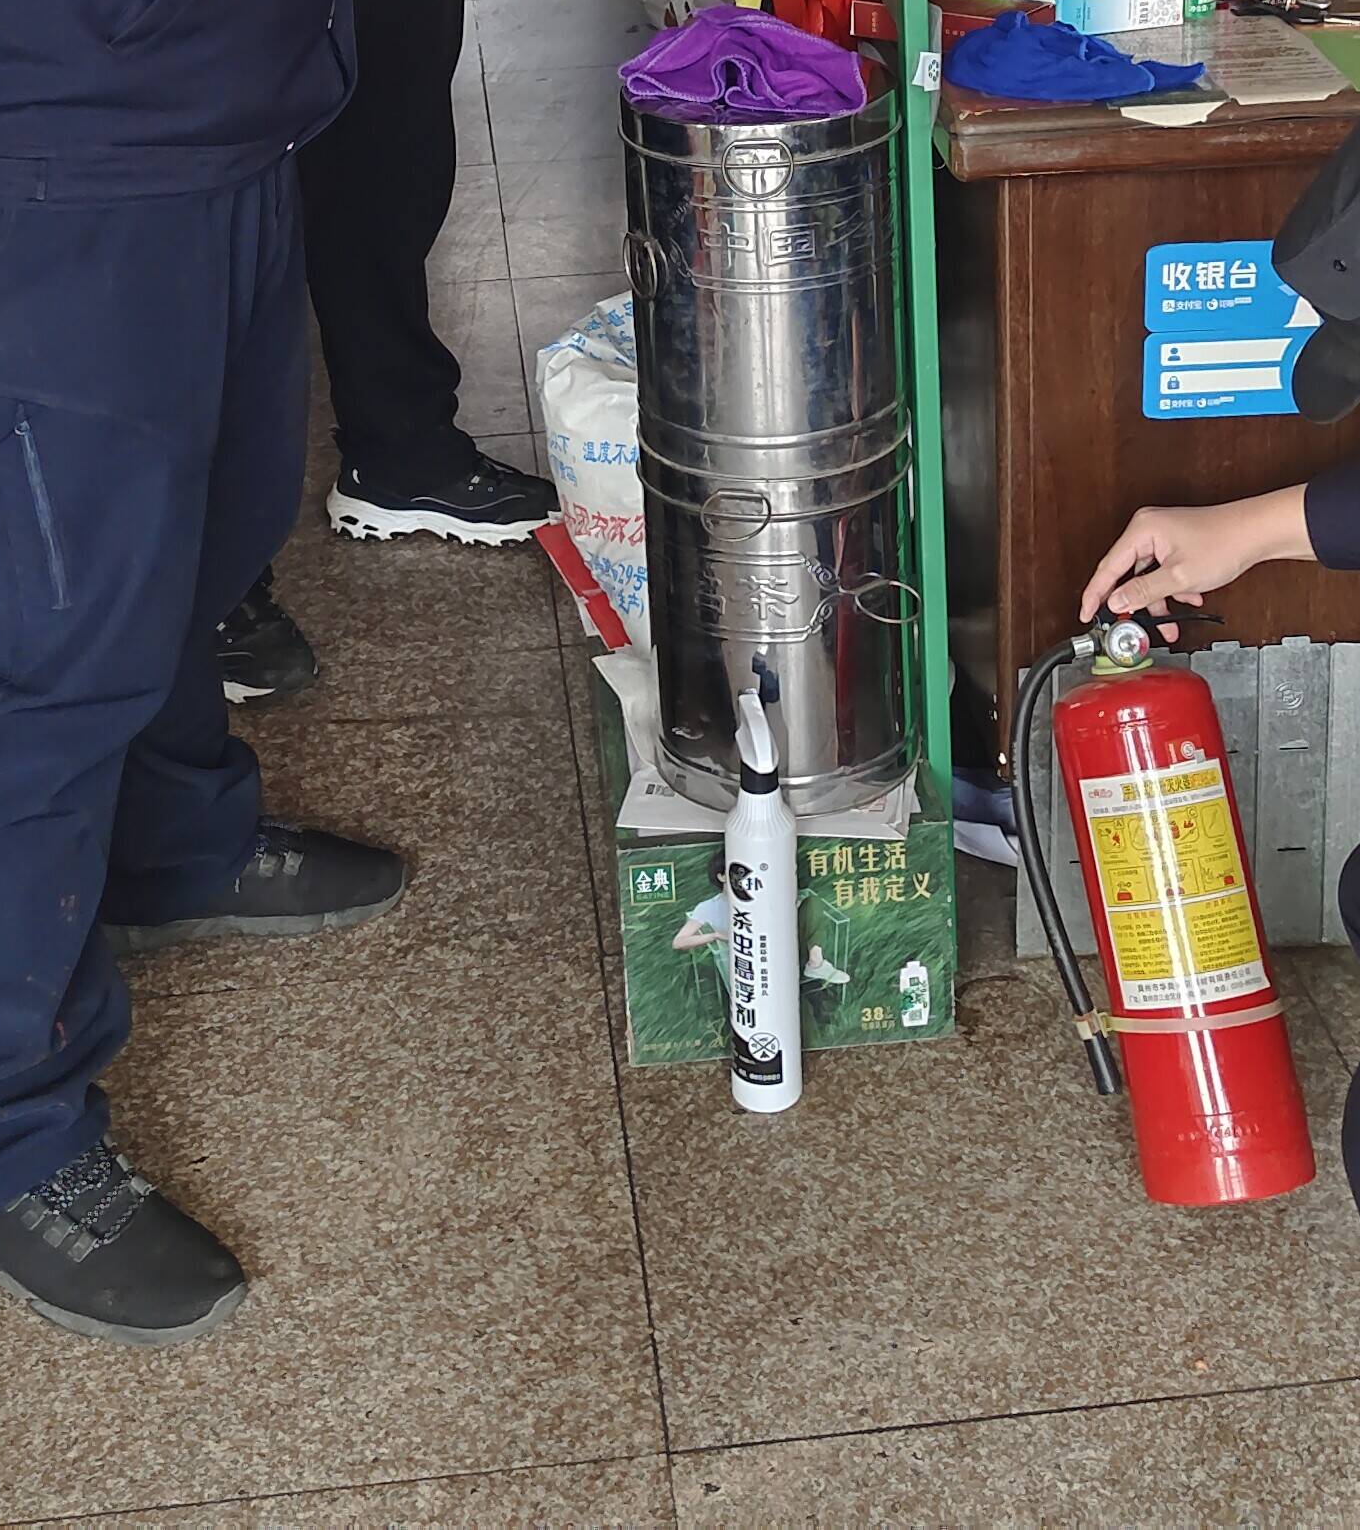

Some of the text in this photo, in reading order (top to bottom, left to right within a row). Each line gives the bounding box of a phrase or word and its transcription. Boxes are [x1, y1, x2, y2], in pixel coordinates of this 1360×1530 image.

[1161, 260, 1257, 291] 收银台
[807, 843, 908, 878] 有机生活
[634, 868, 670, 895] 金典
[832, 871, 932, 909] 有我定义
